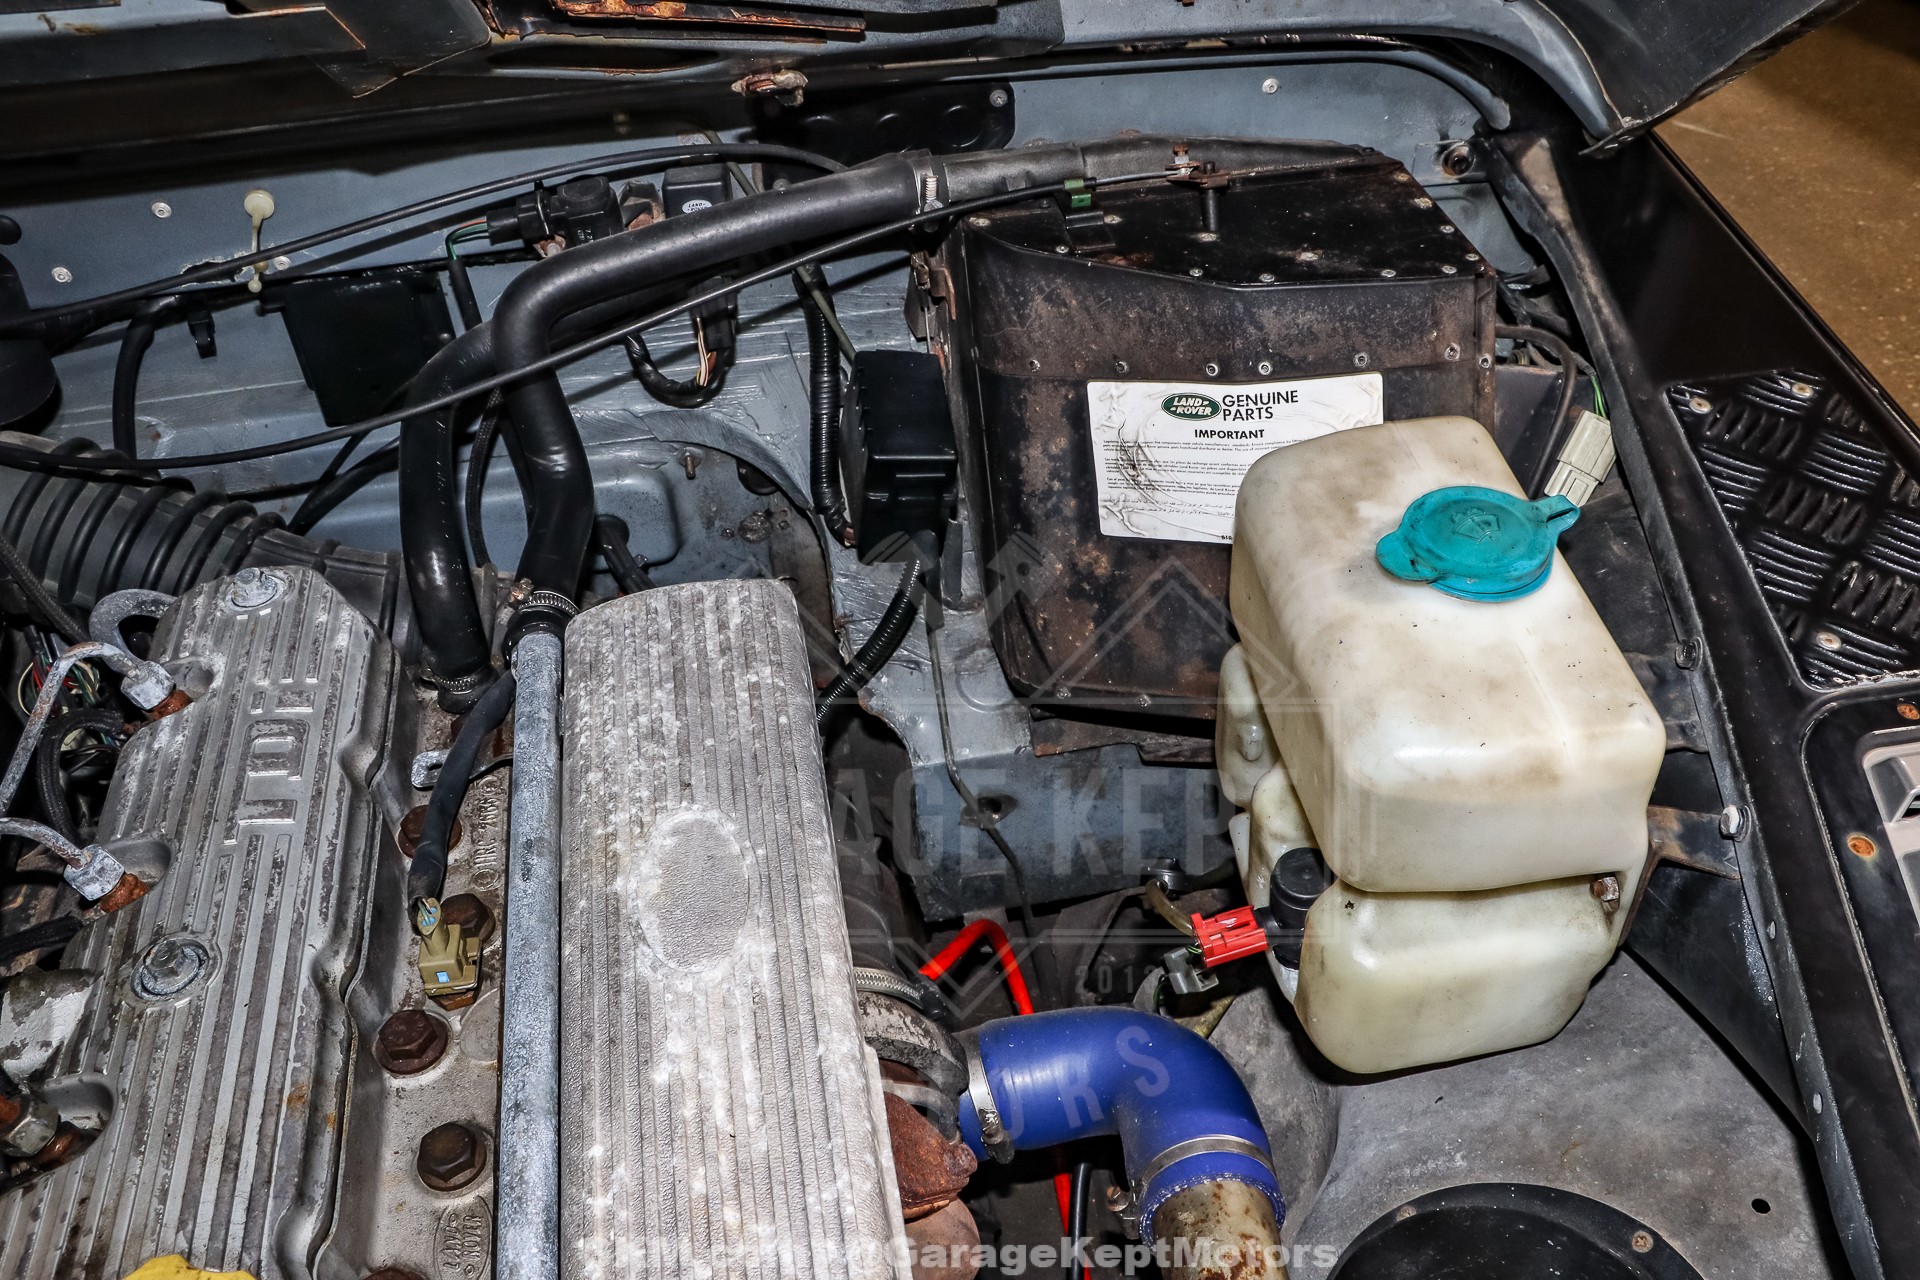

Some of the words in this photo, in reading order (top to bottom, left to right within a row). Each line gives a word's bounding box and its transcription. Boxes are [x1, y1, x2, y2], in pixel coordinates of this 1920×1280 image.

[1222, 390, 1299, 408] GENUINE
[1222, 406, 1274, 421] PARTS
[1194, 429, 1265, 439] IMPORTANT
[462, 1215, 482, 1261] ROVER
